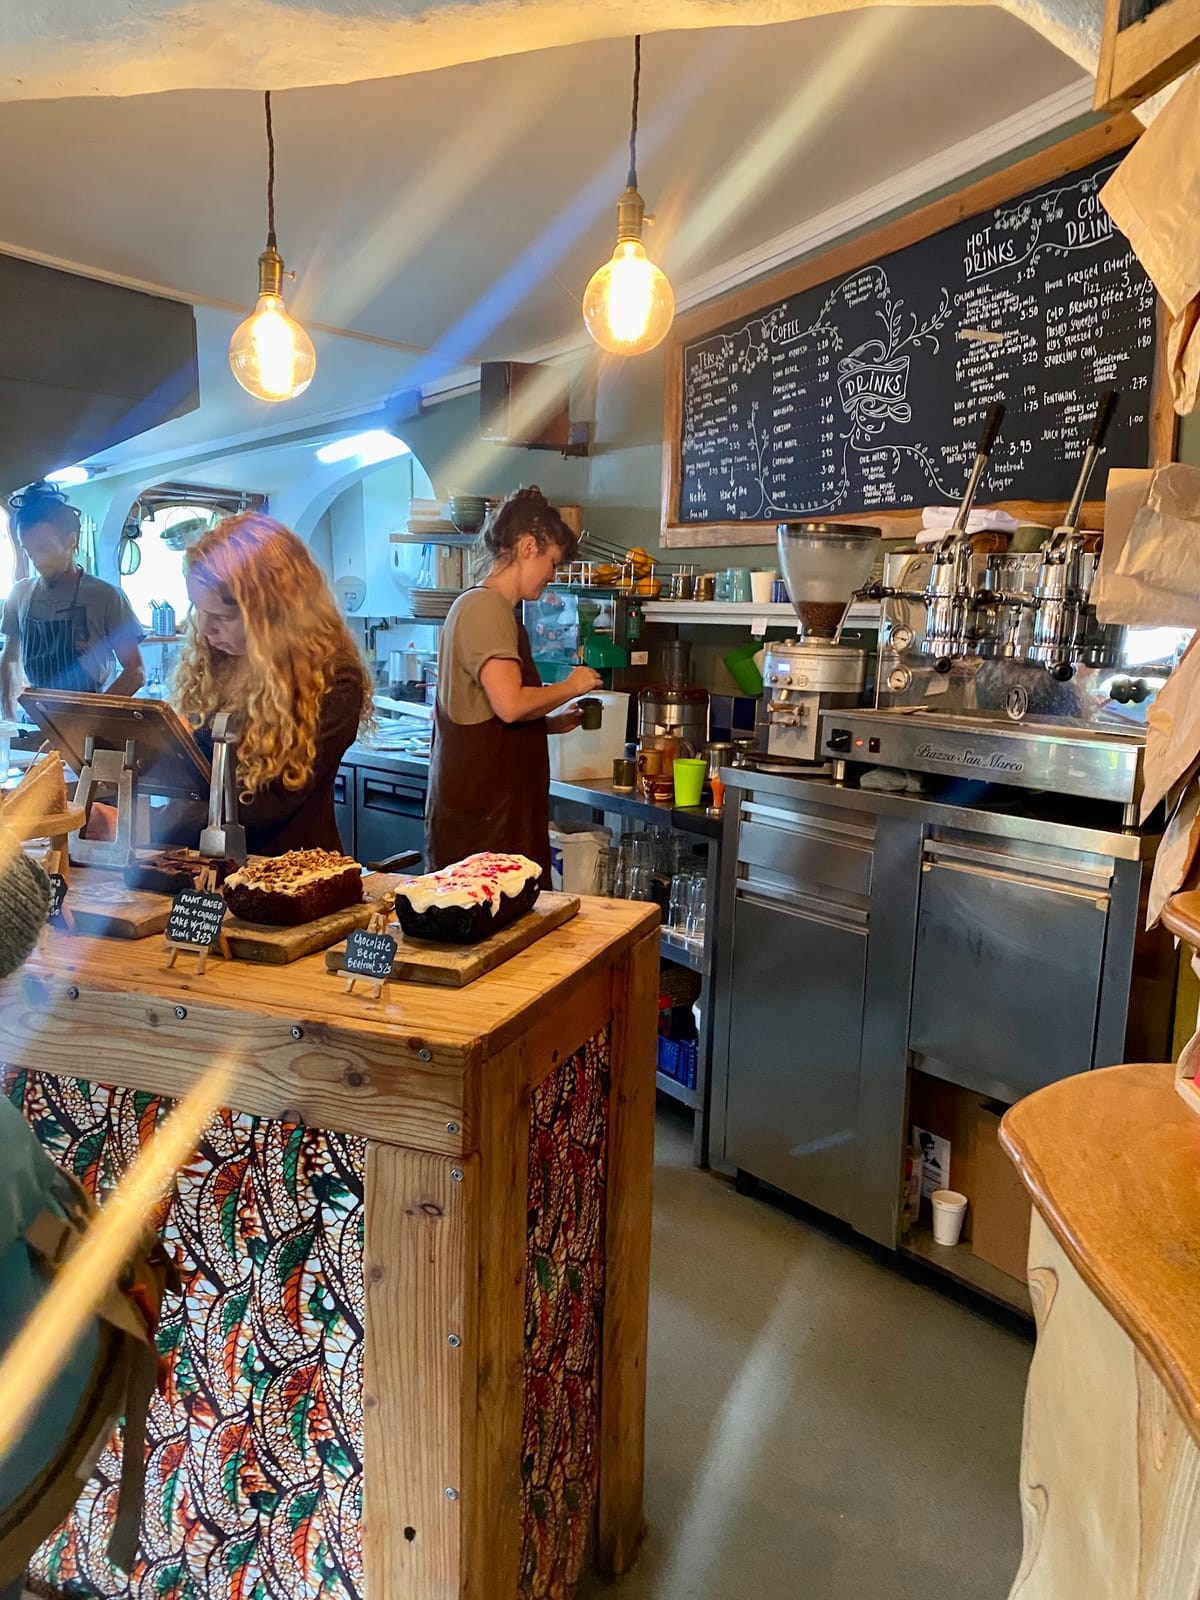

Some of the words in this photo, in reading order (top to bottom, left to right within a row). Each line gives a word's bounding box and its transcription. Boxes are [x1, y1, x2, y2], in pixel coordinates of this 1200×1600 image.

[1077, 193, 1104, 219] COL
[966, 226, 992, 257] HOT
[1065, 213, 1121, 246] DRINK
[963, 238, 1017, 277] DRINKS
[1120, 271, 1130, 288] 3
[845, 370, 903, 397] DRINKS
[915, 744, 956, 762] Piazza
[957, 748, 982, 766] San
[982, 752, 1024, 772] Marco
[180, 894, 202, 905] PLANT
[169, 916, 189, 928] CAKE
[353, 932, 392, 952] Chocolate
[357, 947, 380, 960] Beer
